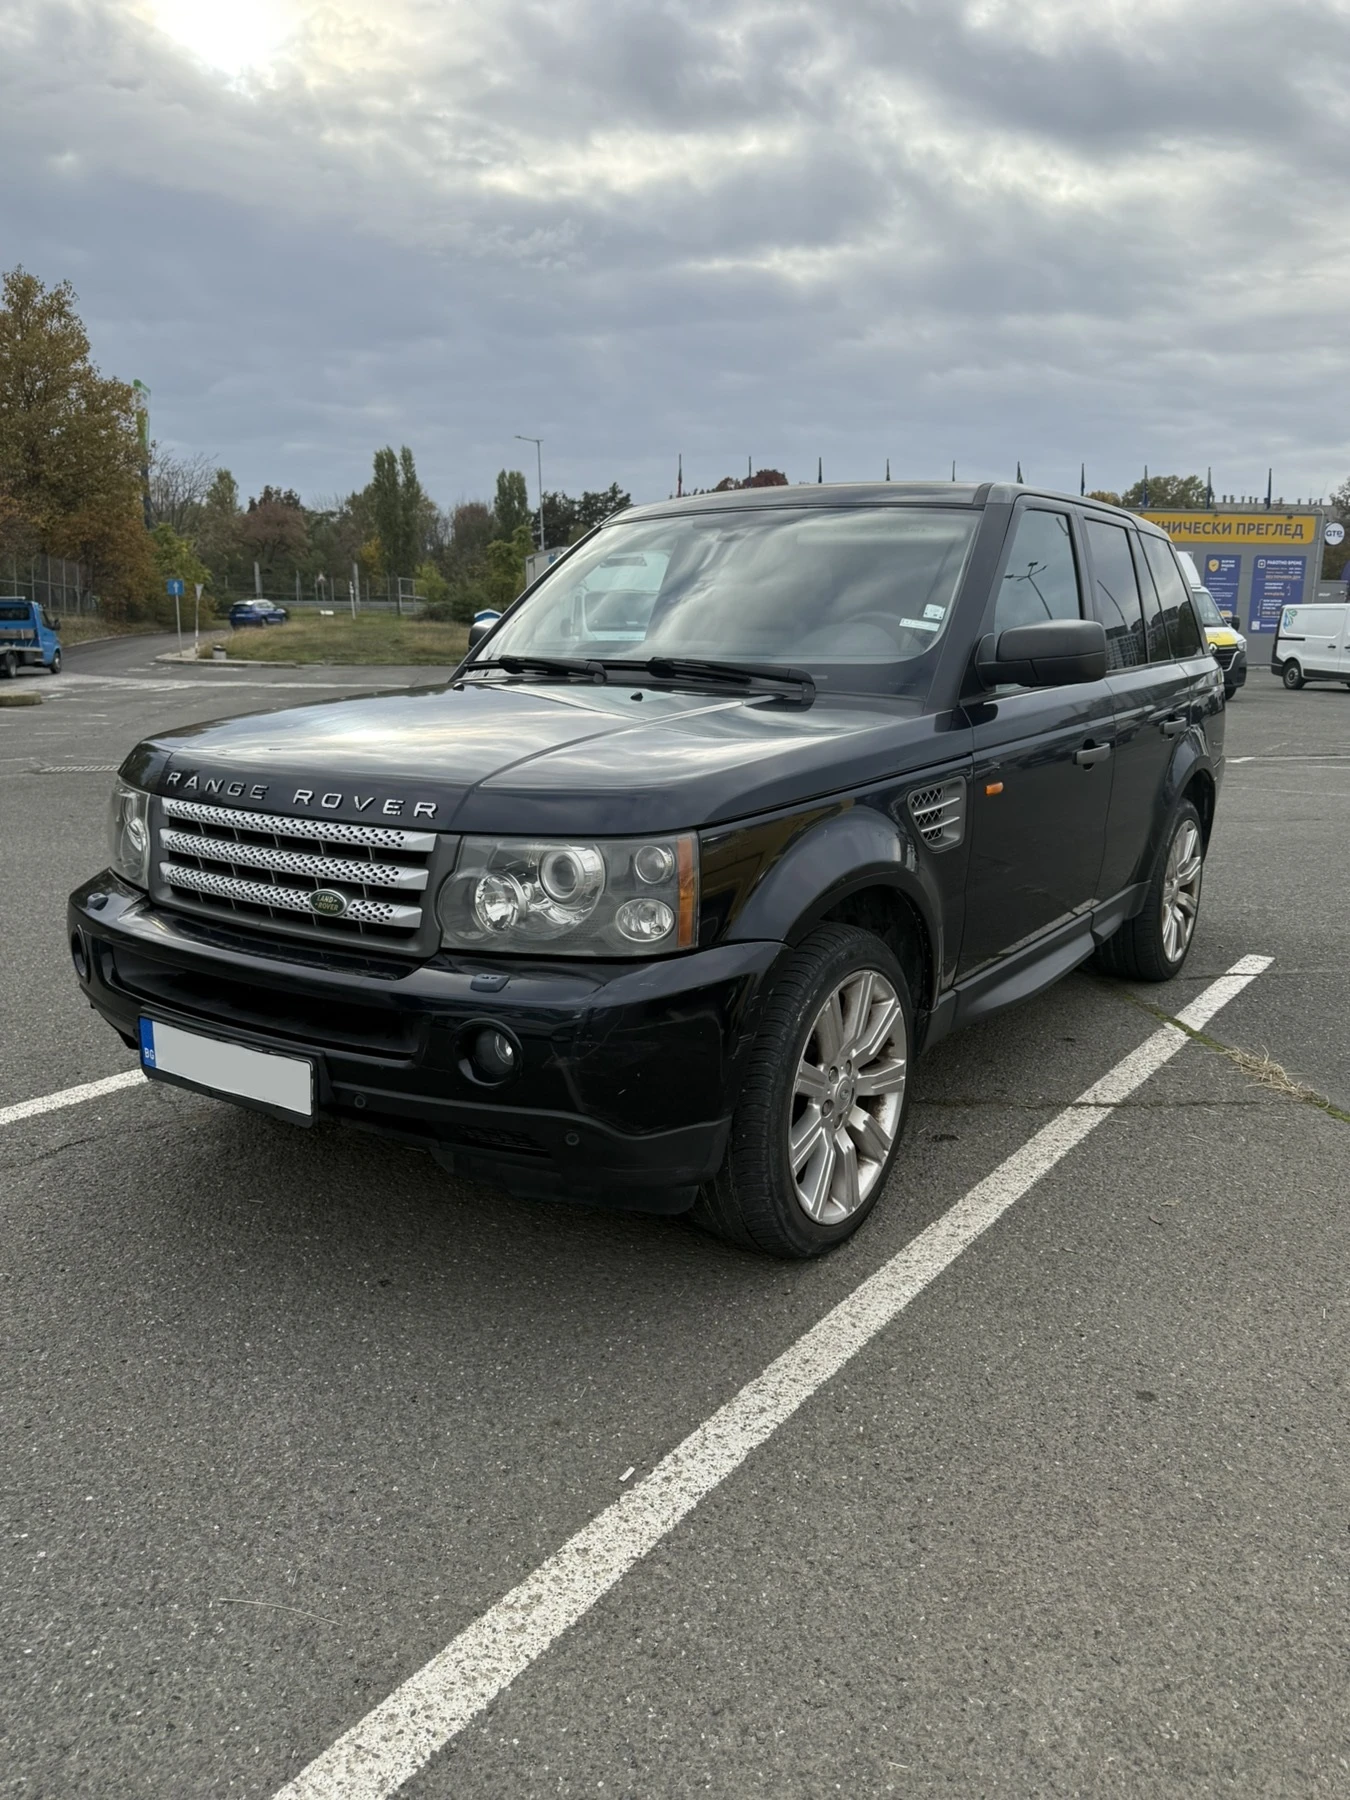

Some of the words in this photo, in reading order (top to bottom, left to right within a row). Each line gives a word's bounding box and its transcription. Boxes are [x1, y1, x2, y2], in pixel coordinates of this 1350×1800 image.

[1236, 523, 1304, 539] ПРЕГЛЕД
[166, 772, 269, 800] RANGE
[293, 789, 439, 819] ROVER
[317, 895, 334, 903] LAND
[317, 902, 339, 910] ROVER
[144, 1047, 155, 1060] BG
